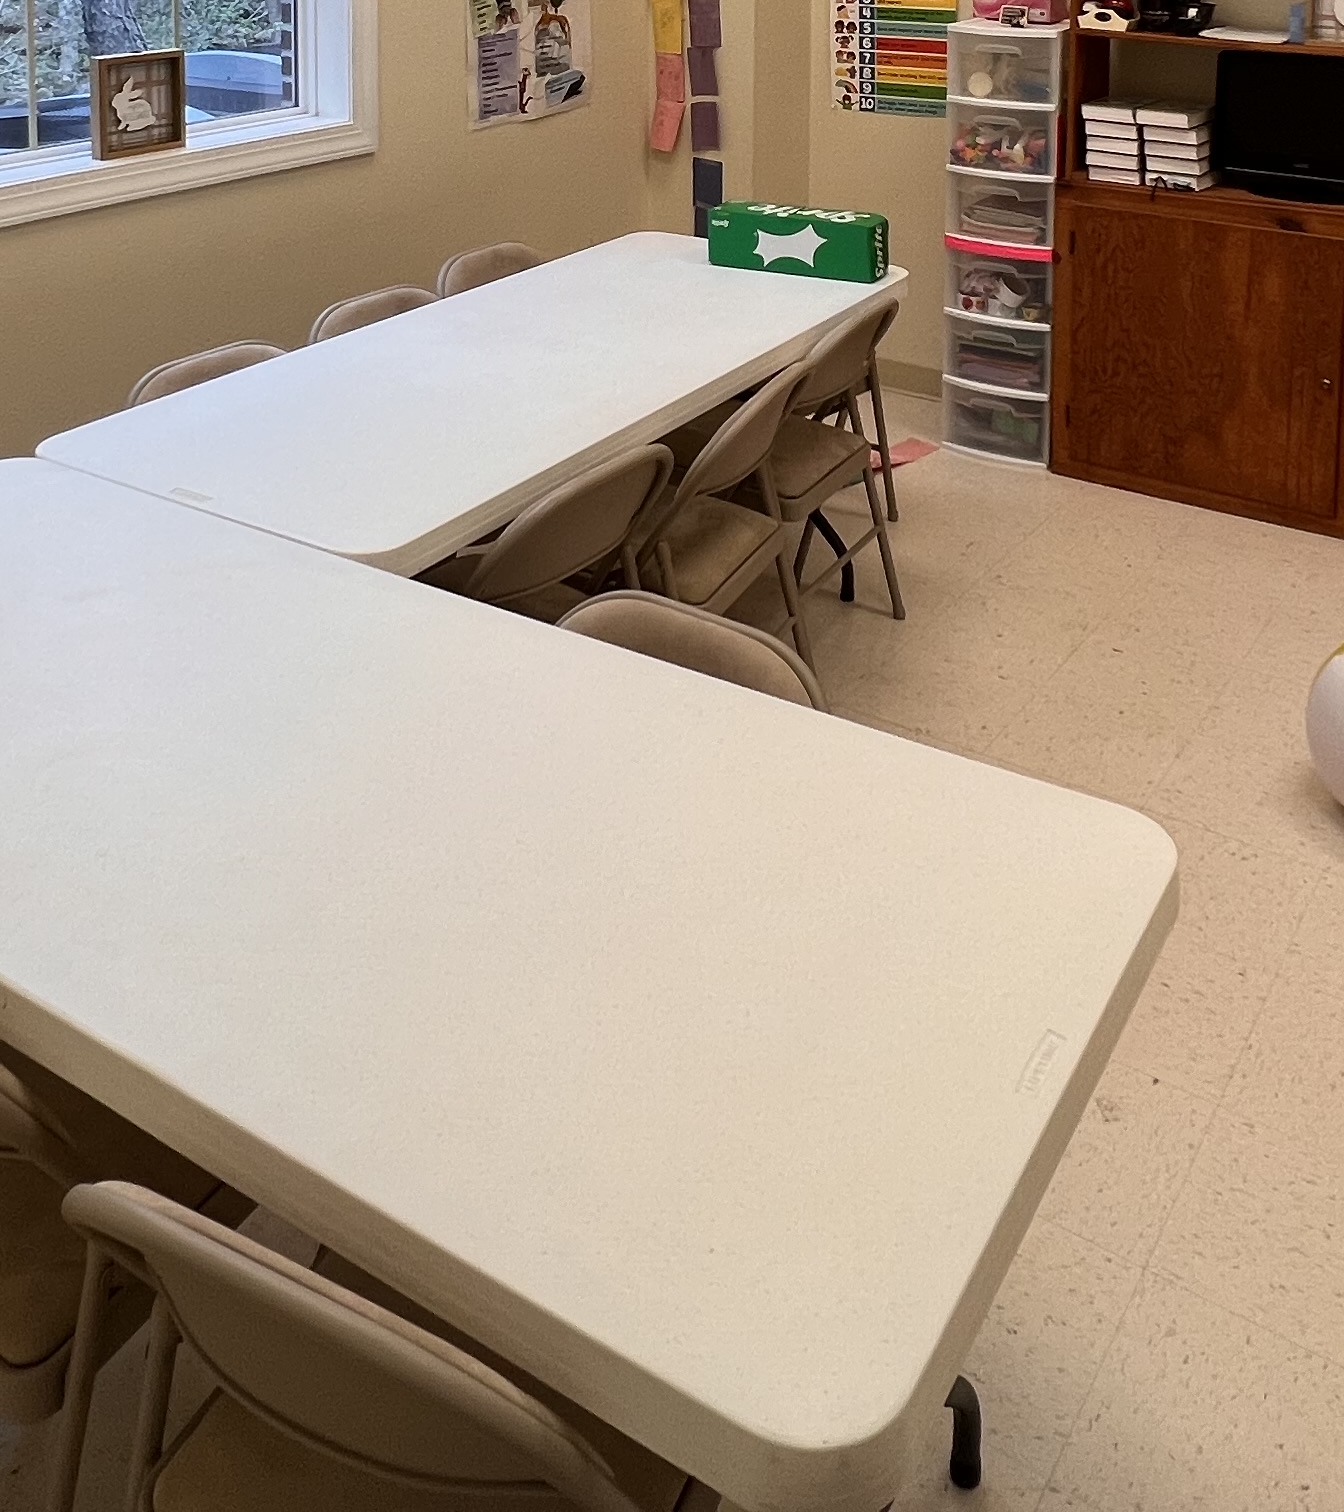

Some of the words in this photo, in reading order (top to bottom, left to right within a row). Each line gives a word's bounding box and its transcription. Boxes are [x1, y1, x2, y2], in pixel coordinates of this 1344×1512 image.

[862, 7, 871, 18] 4
[862, 23, 871, 34] 5
[862, 38, 872, 49] 6
[862, 53, 871, 64] 7
[862, 68, 872, 78] 8
[862, 82, 872, 93] 9
[860, 98, 874, 109] 10
[874, 224, 884, 279] Sprite
